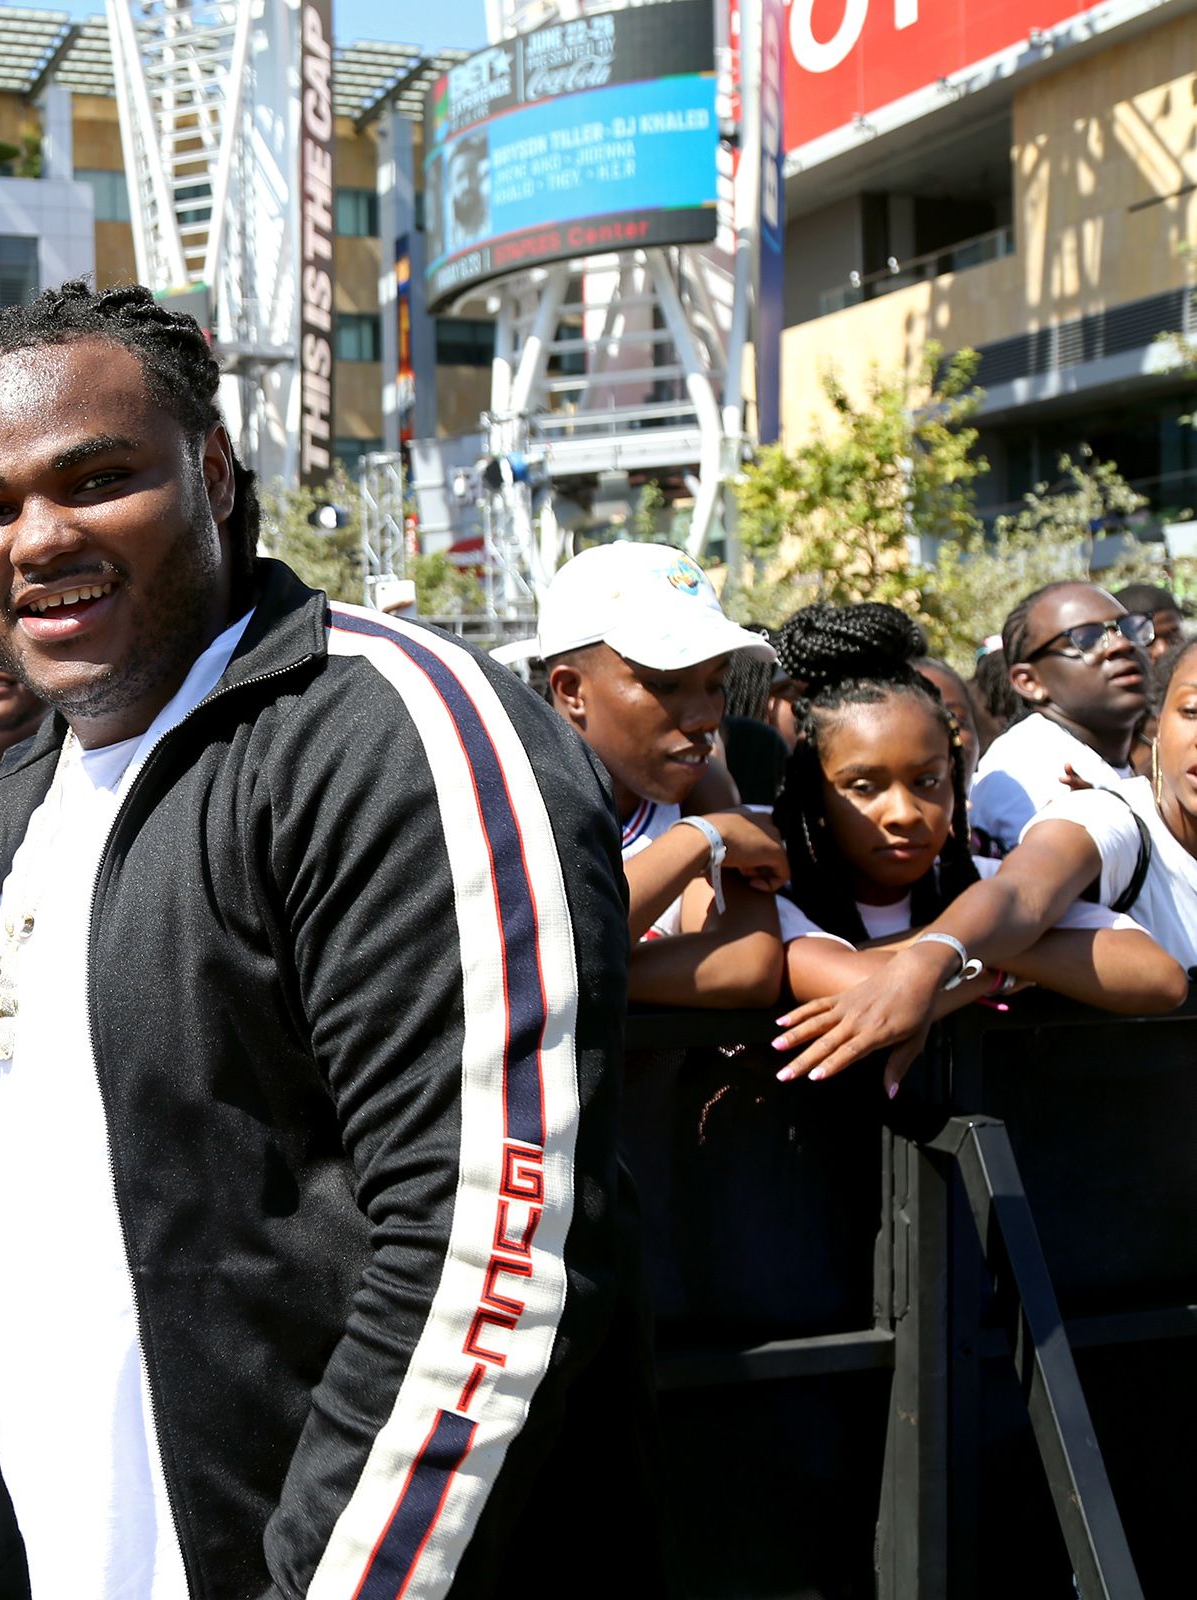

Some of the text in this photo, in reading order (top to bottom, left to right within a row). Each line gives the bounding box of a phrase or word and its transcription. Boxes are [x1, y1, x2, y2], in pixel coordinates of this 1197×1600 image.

[528, 26, 564, 53] JUNE
[449, 49, 495, 97] BET
[492, 108, 709, 167] BRYSON TILLER DJ KHALED
[303, 137, 332, 261] THE
[493, 231, 561, 266] STAPLES
[566, 220, 650, 248] Center
[303, 265, 332, 333] IS
[303, 332, 331, 474] THIS
[456, 1142, 545, 1413] GUCCI
